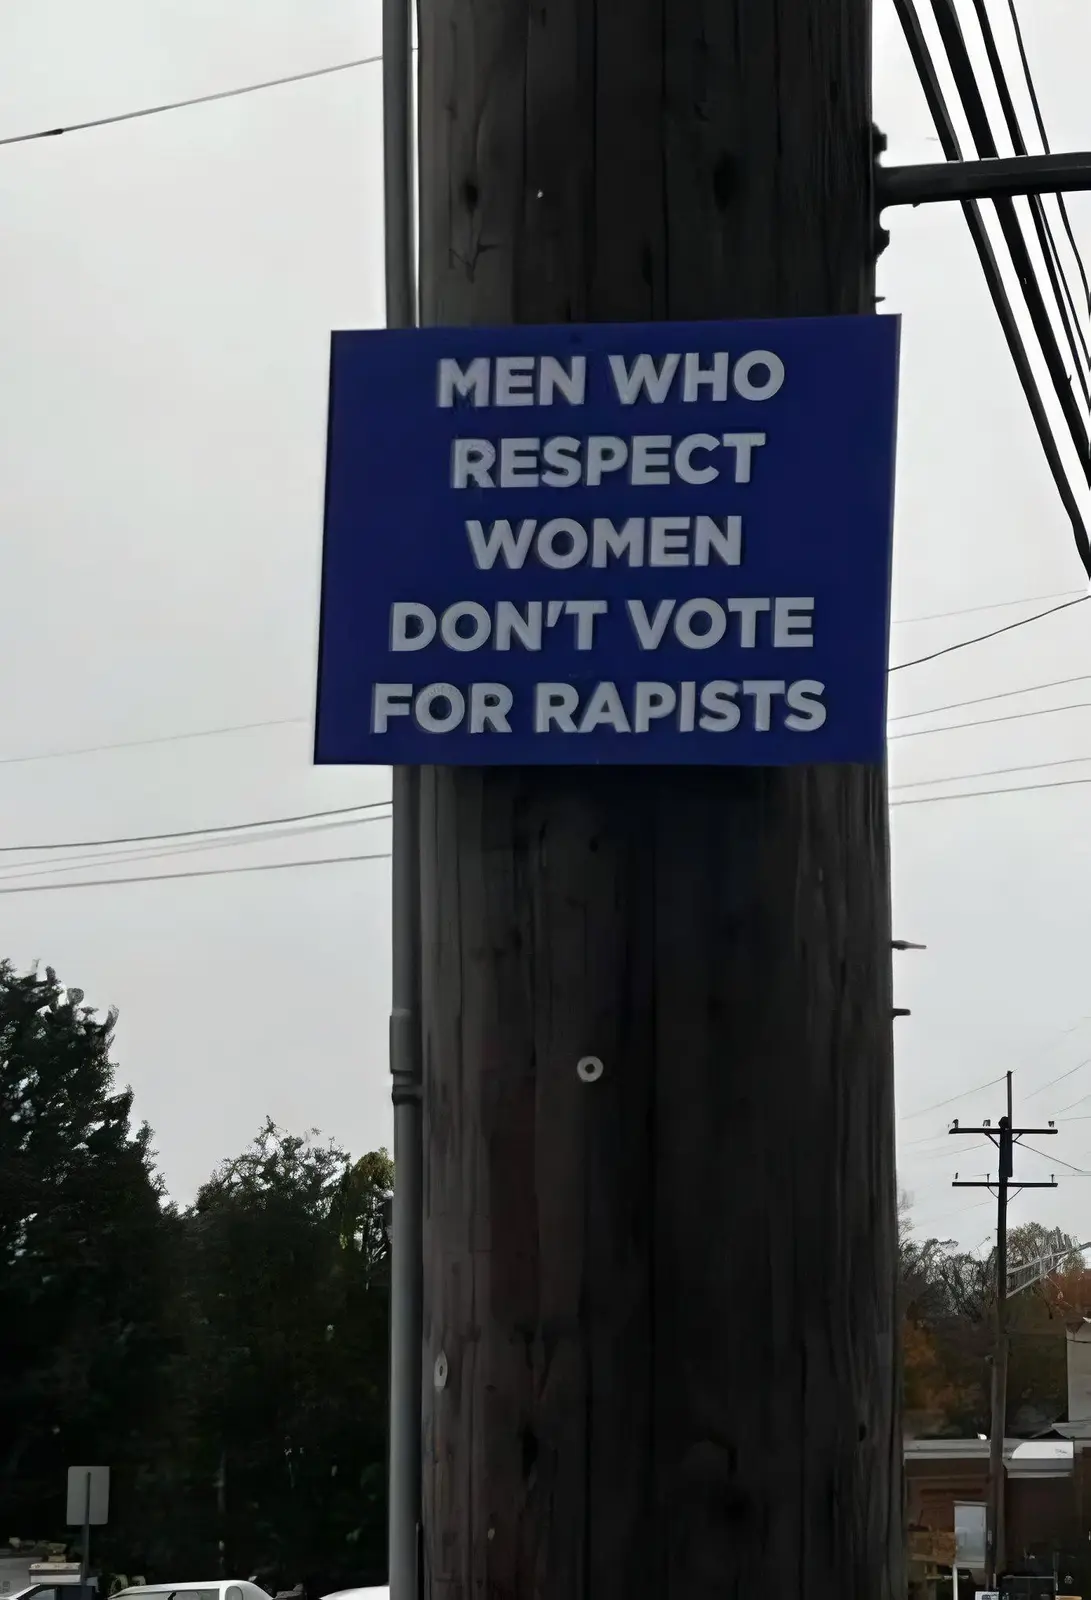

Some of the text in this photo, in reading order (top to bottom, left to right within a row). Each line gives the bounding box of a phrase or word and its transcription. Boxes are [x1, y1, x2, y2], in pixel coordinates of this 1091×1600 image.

[436, 350, 785, 409] MEN WHO
[451, 432, 767, 491] RESPECT
[465, 514, 742, 571] WOMEN
[390, 596, 815, 653] DON'T VOTE
[372, 679, 827, 735] FOR RAPISTS
